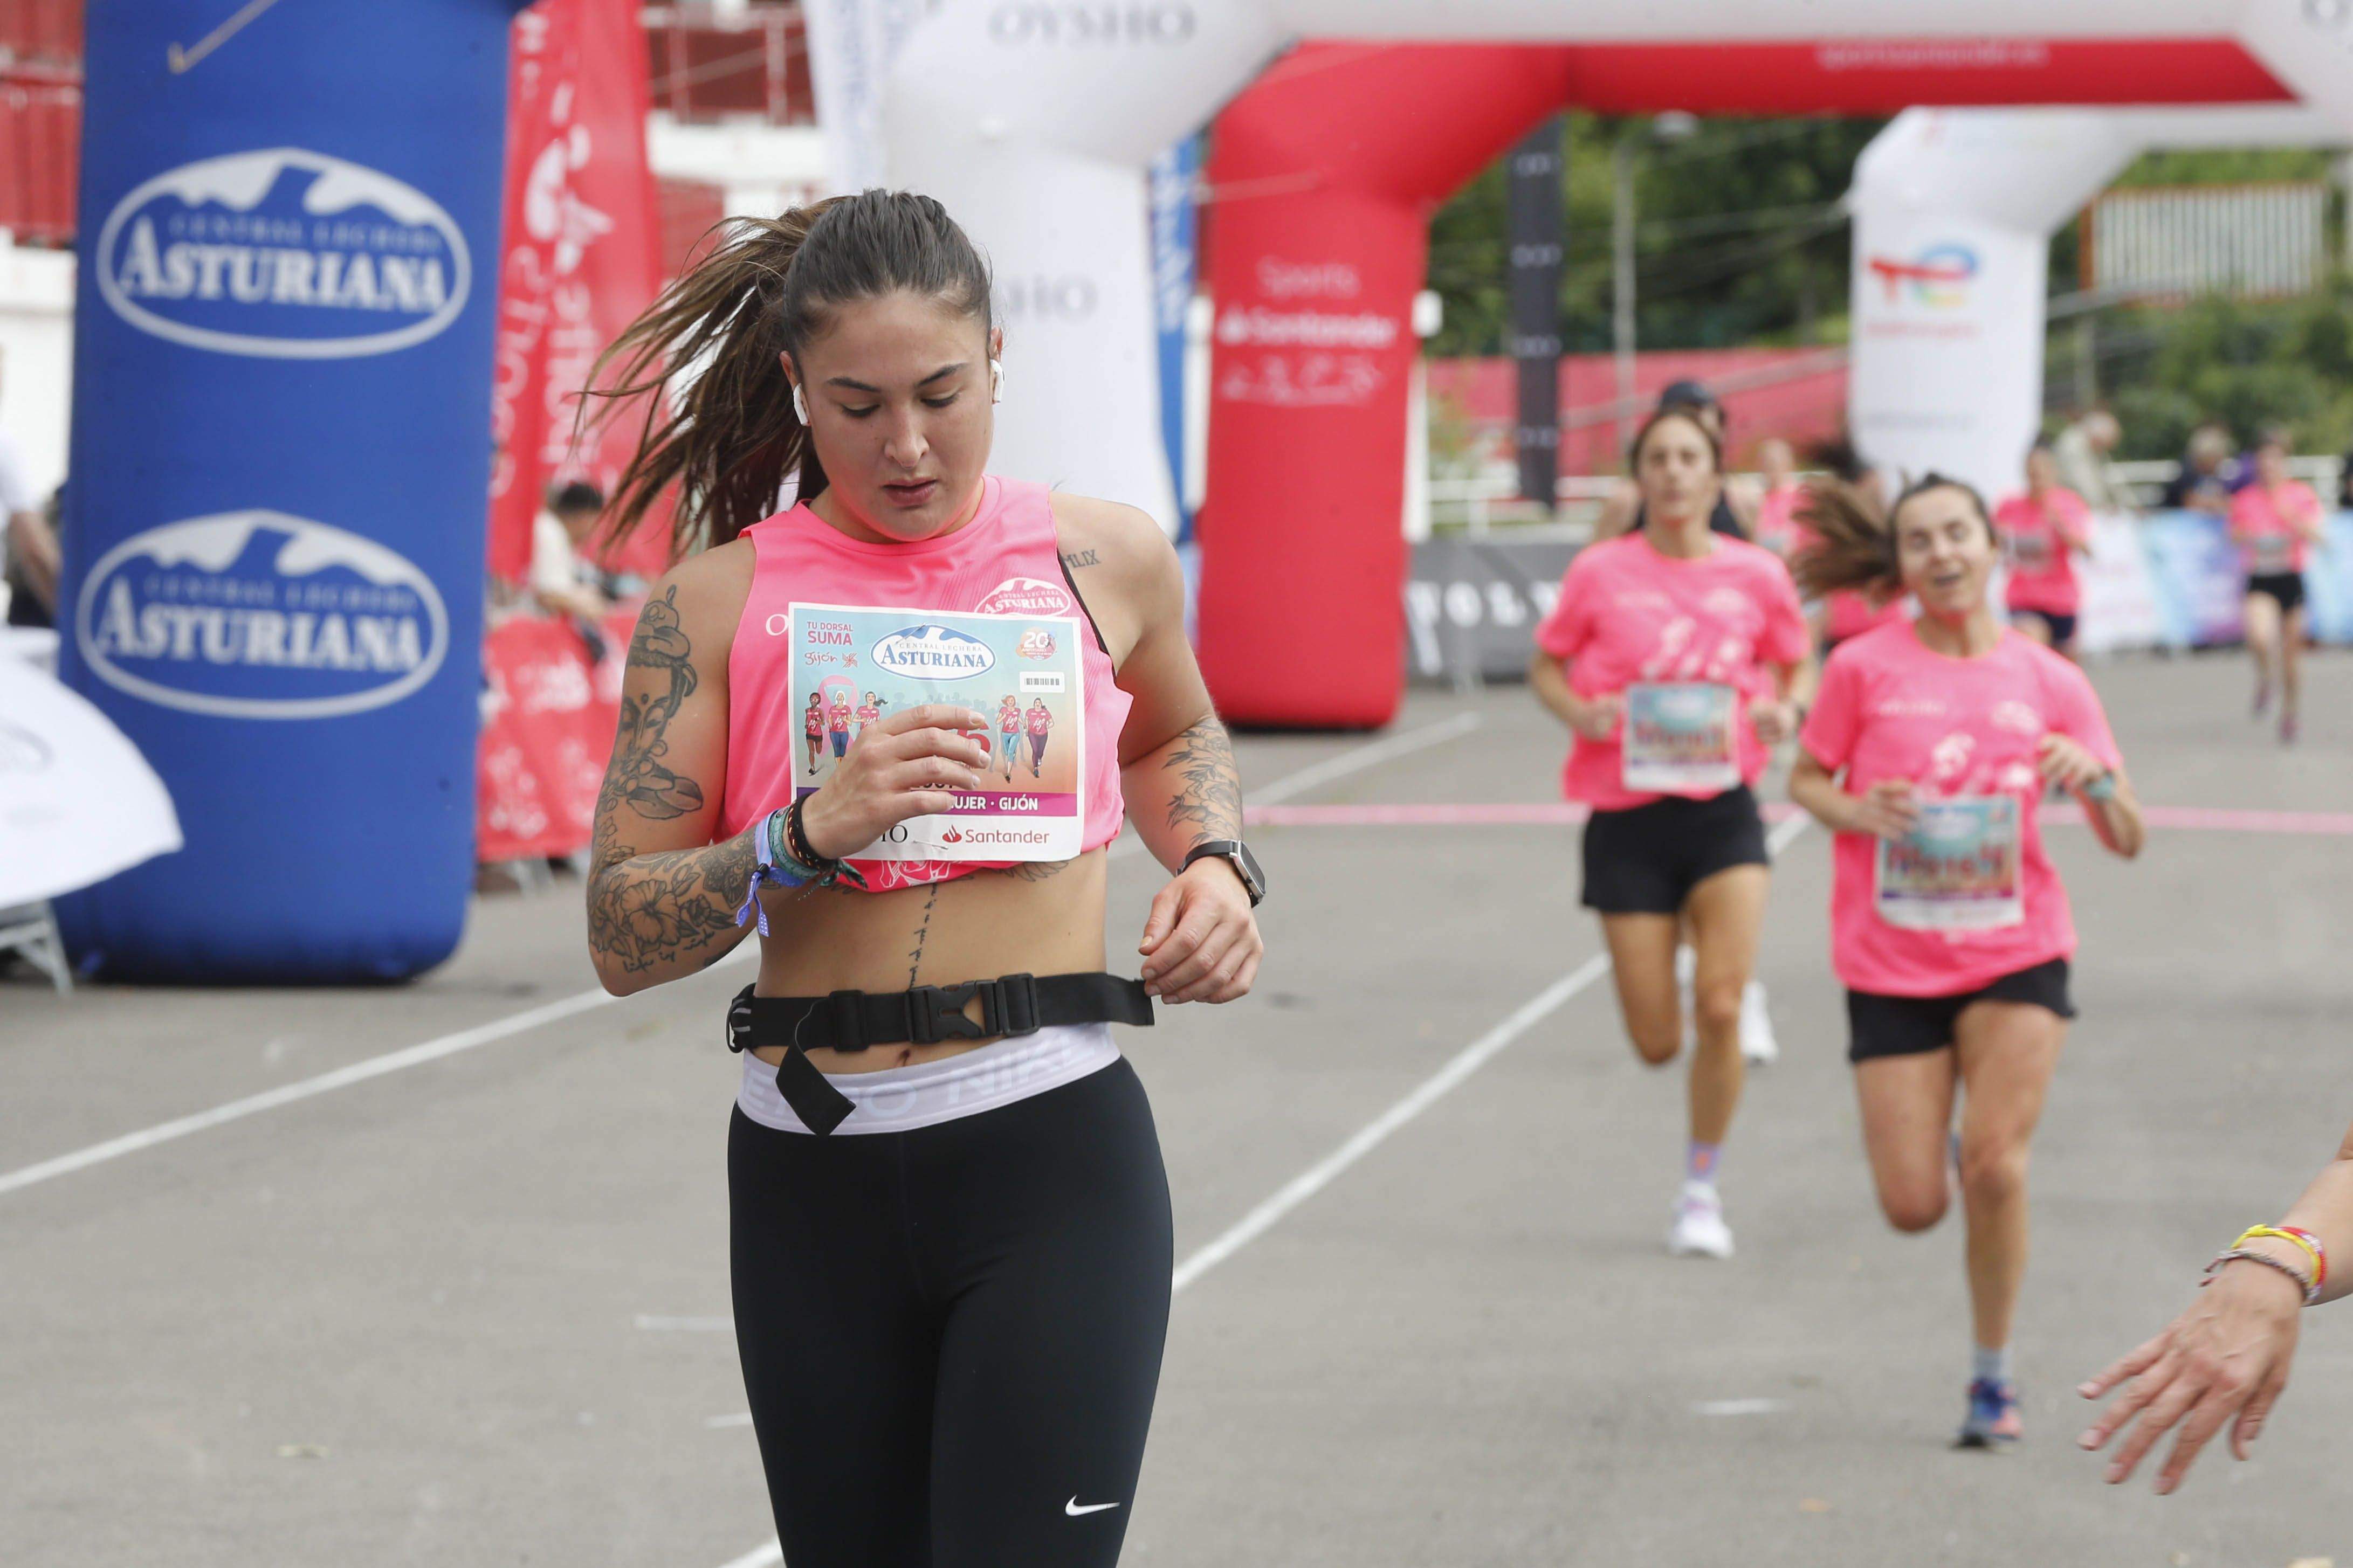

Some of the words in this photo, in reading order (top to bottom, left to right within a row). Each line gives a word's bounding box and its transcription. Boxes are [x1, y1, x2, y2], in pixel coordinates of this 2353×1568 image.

[122, 217, 448, 313] ASTURIANA
[985, 597, 1065, 613] ASTURIANA
[98, 575, 422, 672] ASTURIANA
[807, 621, 817, 630] TU
[820, 623, 854, 632] DORSAL
[808, 631, 852, 646] SUMA
[880, 644, 987, 668] ASTURIANA
[999, 793, 1038, 811] GIJÓN
[965, 828, 1050, 844] Santander
